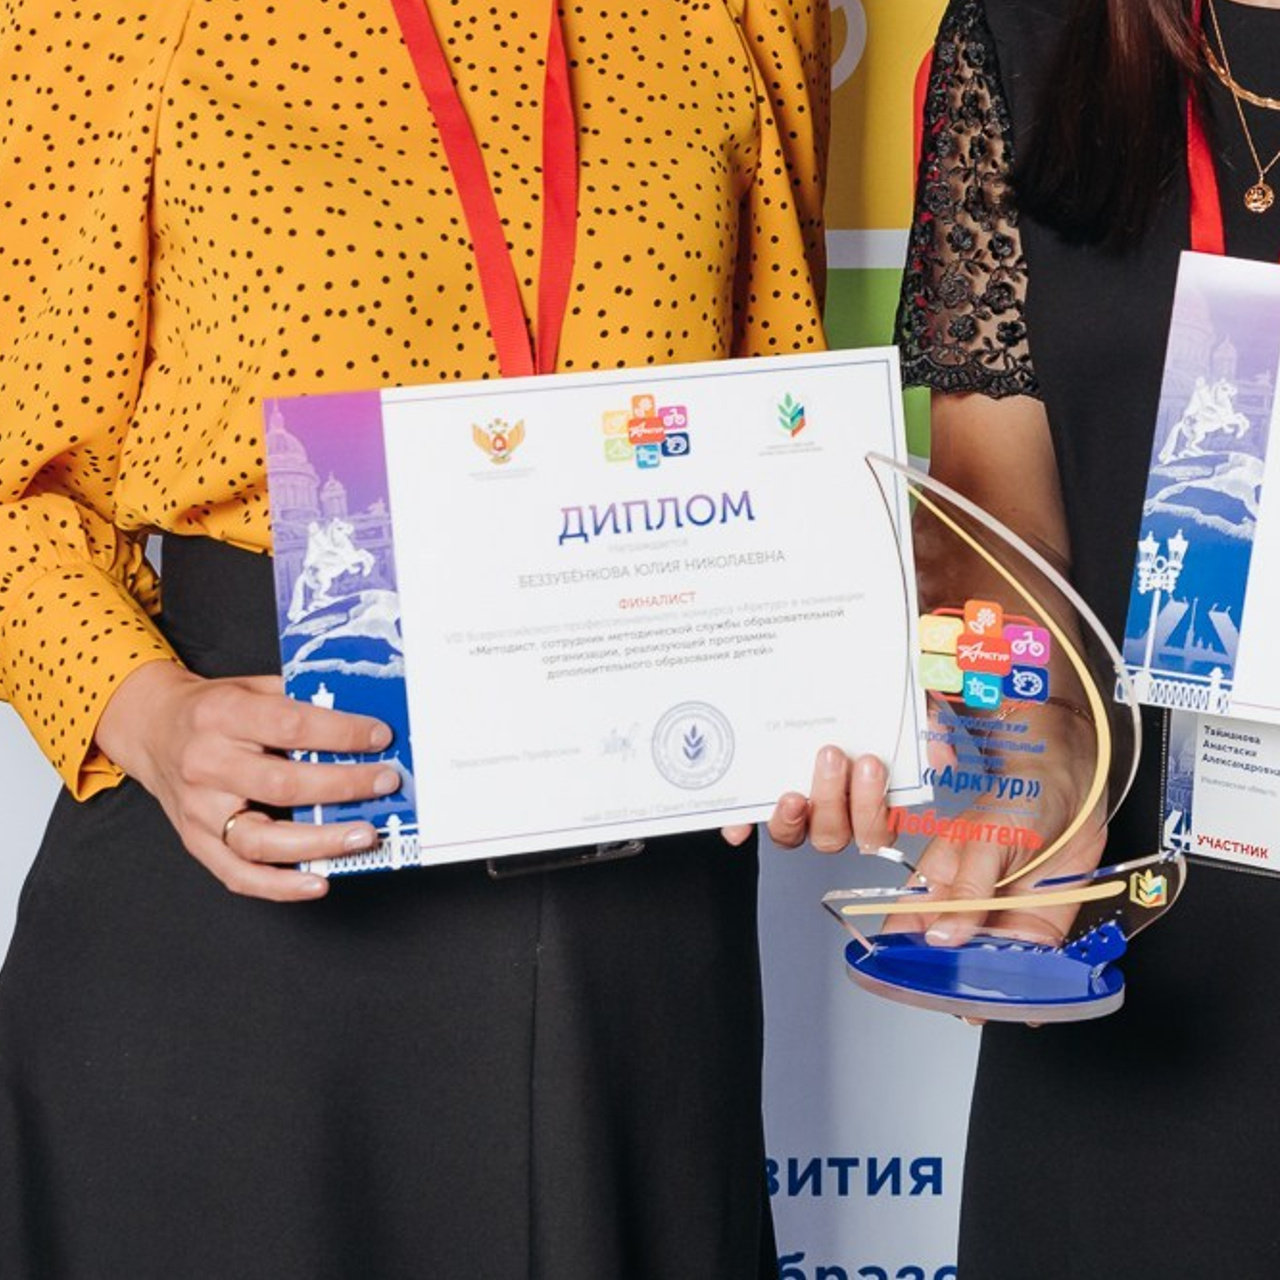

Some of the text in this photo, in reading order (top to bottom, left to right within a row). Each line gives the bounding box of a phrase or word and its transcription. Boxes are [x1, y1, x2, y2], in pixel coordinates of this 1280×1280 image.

[557, 490, 756, 546] ДИПЛОМ
[634, 560, 680, 577] ЮЛИЯ
[684, 549, 786, 569] НИКОЛАЕВНА
[618, 591, 697, 610] ФИНАЛИСТ
[541, 634, 605, 651] сотрудник
[607, 624, 692, 642] методической
[695, 618, 741, 635] службы
[744, 607, 845, 627] образовательной
[709, 631, 777, 648] программы
[655, 650, 730, 668] образования
[1204, 725, 1261, 745] Тайманова
[1203, 740, 1257, 757] Анастасия
[923, 765, 1040, 799] «Арктур»
[887, 806, 1044, 850] Победитель
[1197, 834, 1269, 859] УЧАСТНИК
